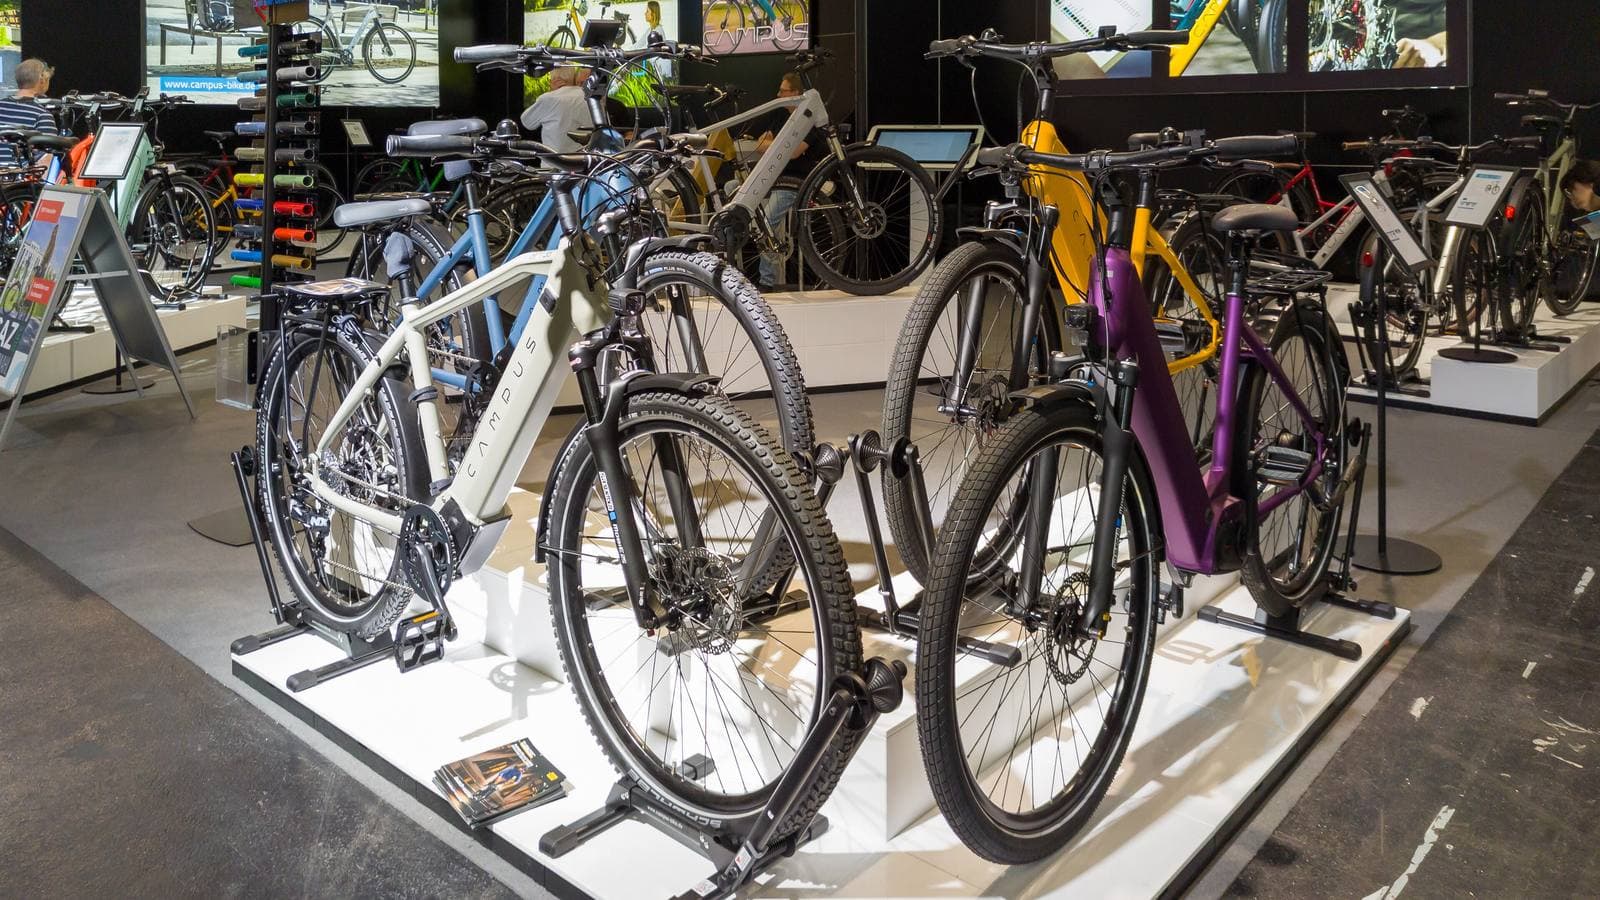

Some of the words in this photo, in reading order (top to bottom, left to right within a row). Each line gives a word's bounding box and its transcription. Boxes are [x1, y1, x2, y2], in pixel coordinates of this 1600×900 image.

[703, 23, 809, 46] CAMPUS
[165, 80, 256, 90] www.campus-bike.de
[0, 317, 20, 351] AZ
[468, 336, 537, 478] CAMPUS
[627, 768, 723, 828] SCHWALBE
